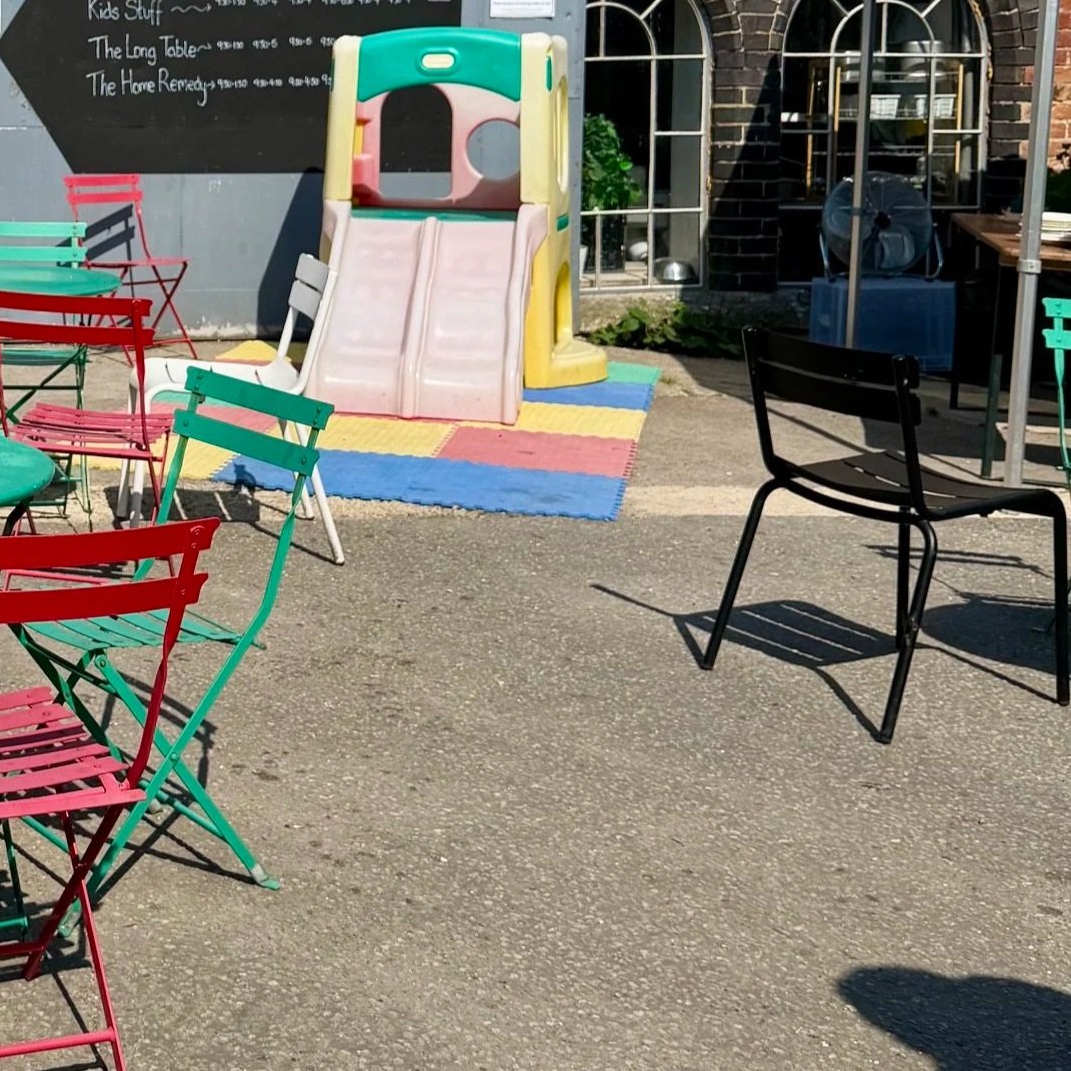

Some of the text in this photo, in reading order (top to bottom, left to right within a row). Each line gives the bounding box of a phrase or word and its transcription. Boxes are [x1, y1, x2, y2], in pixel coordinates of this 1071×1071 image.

[87, 34, 123, 60] The
[125, 33, 158, 66] Long
[158, 34, 197, 59] Table
[85, 69, 117, 97] The
[120, 68, 156, 96] Home
[158, 67, 208, 107] Remedy
